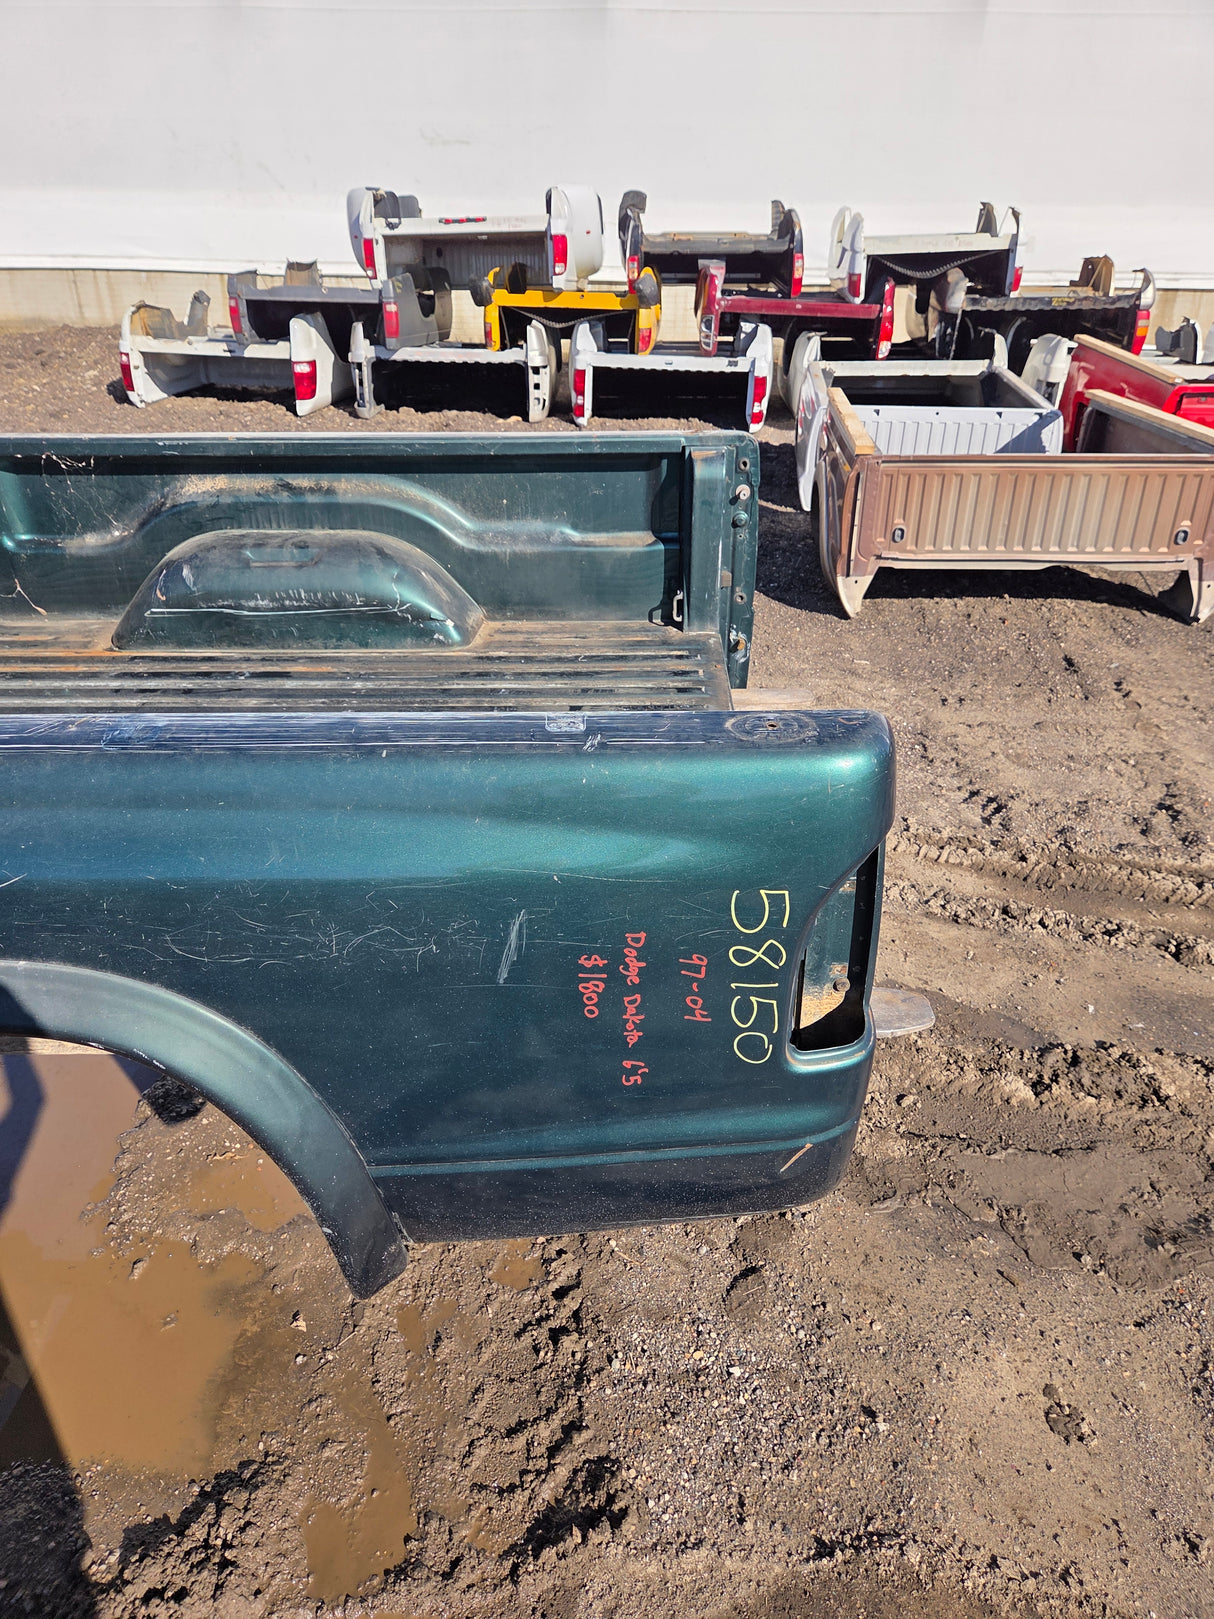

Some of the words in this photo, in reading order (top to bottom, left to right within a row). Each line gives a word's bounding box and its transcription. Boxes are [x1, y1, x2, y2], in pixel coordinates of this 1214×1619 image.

[578, 954, 608, 1018] $1800
[619, 931, 647, 986] Dodge
[679, 954, 712, 1022] 97-04
[728, 889, 791, 1064] 58150
[622, 993, 645, 1048] Dakota
